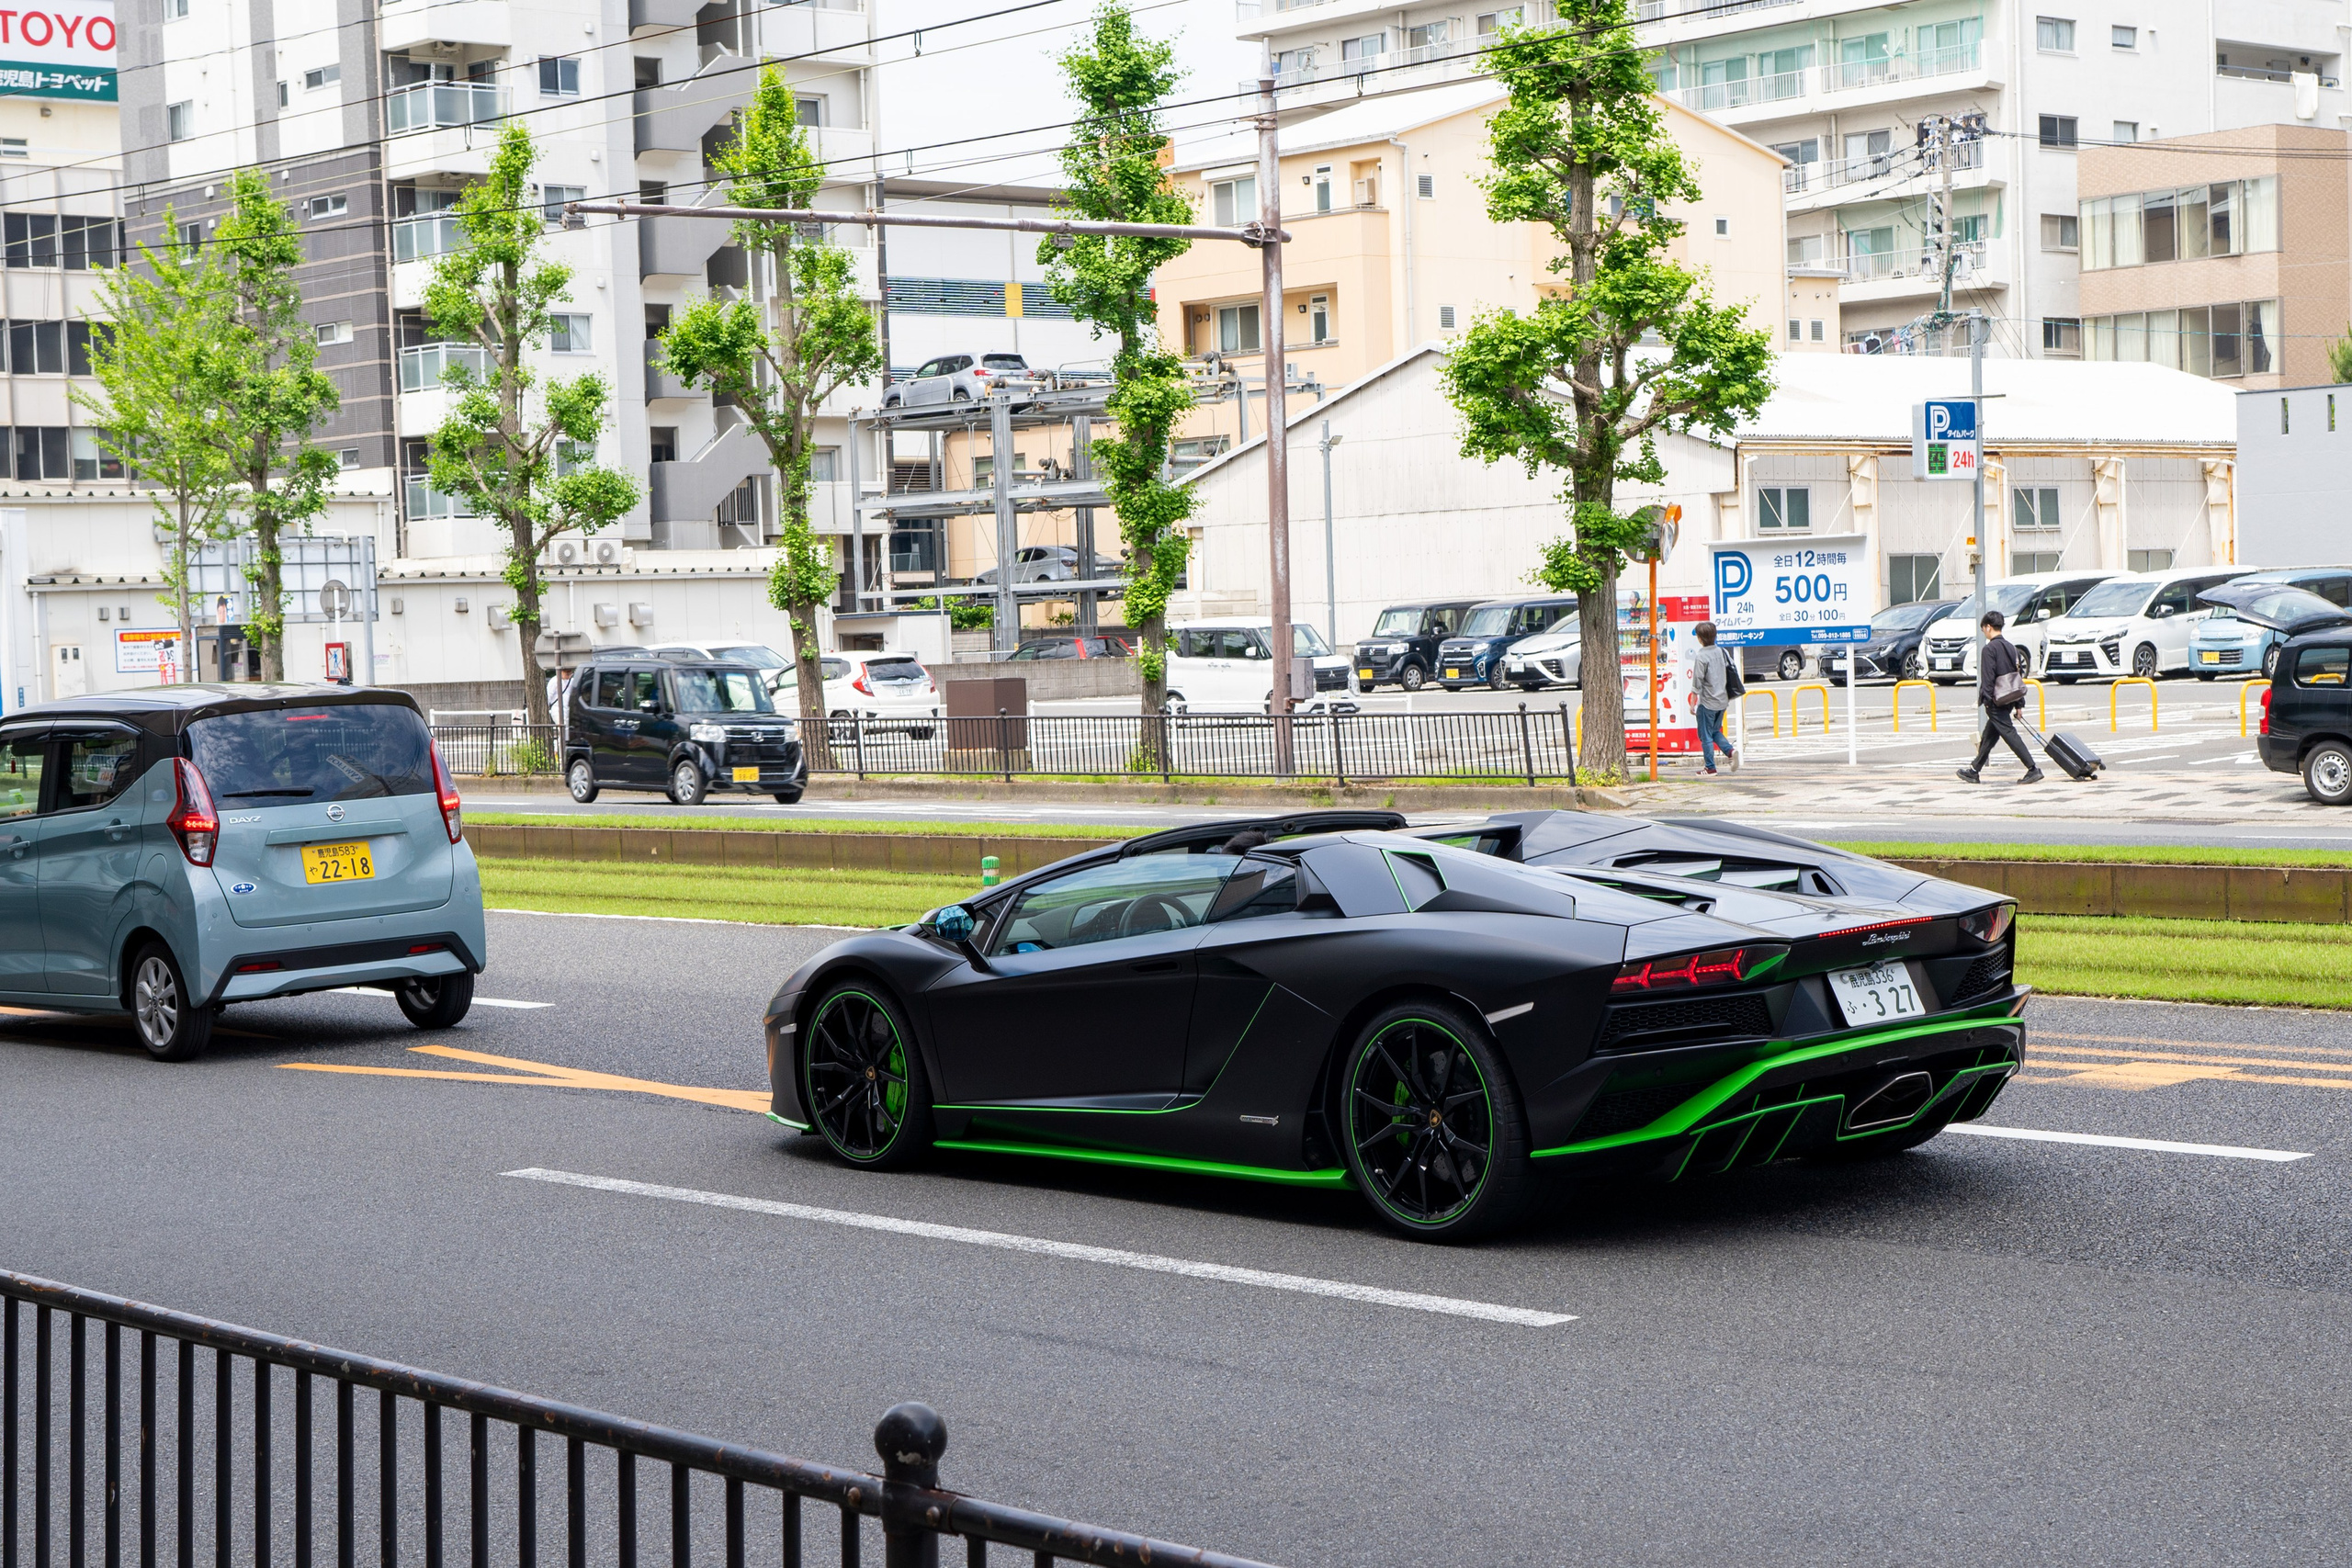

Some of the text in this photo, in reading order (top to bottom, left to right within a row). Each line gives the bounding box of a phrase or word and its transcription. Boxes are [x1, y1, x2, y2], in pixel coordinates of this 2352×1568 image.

[1947, 429, 1974, 438] タイムパーク
[1928, 444, 1947, 474] 空
[1953, 450, 1974, 468] 24h
[1736, 602, 1755, 614] 24h
[1714, 617, 1753, 626] タイムパーク
[229, 816, 262, 825] DAYZ
[320, 856, 370, 879] 22-18
[1862, 931, 1911, 946] Lamborghini
